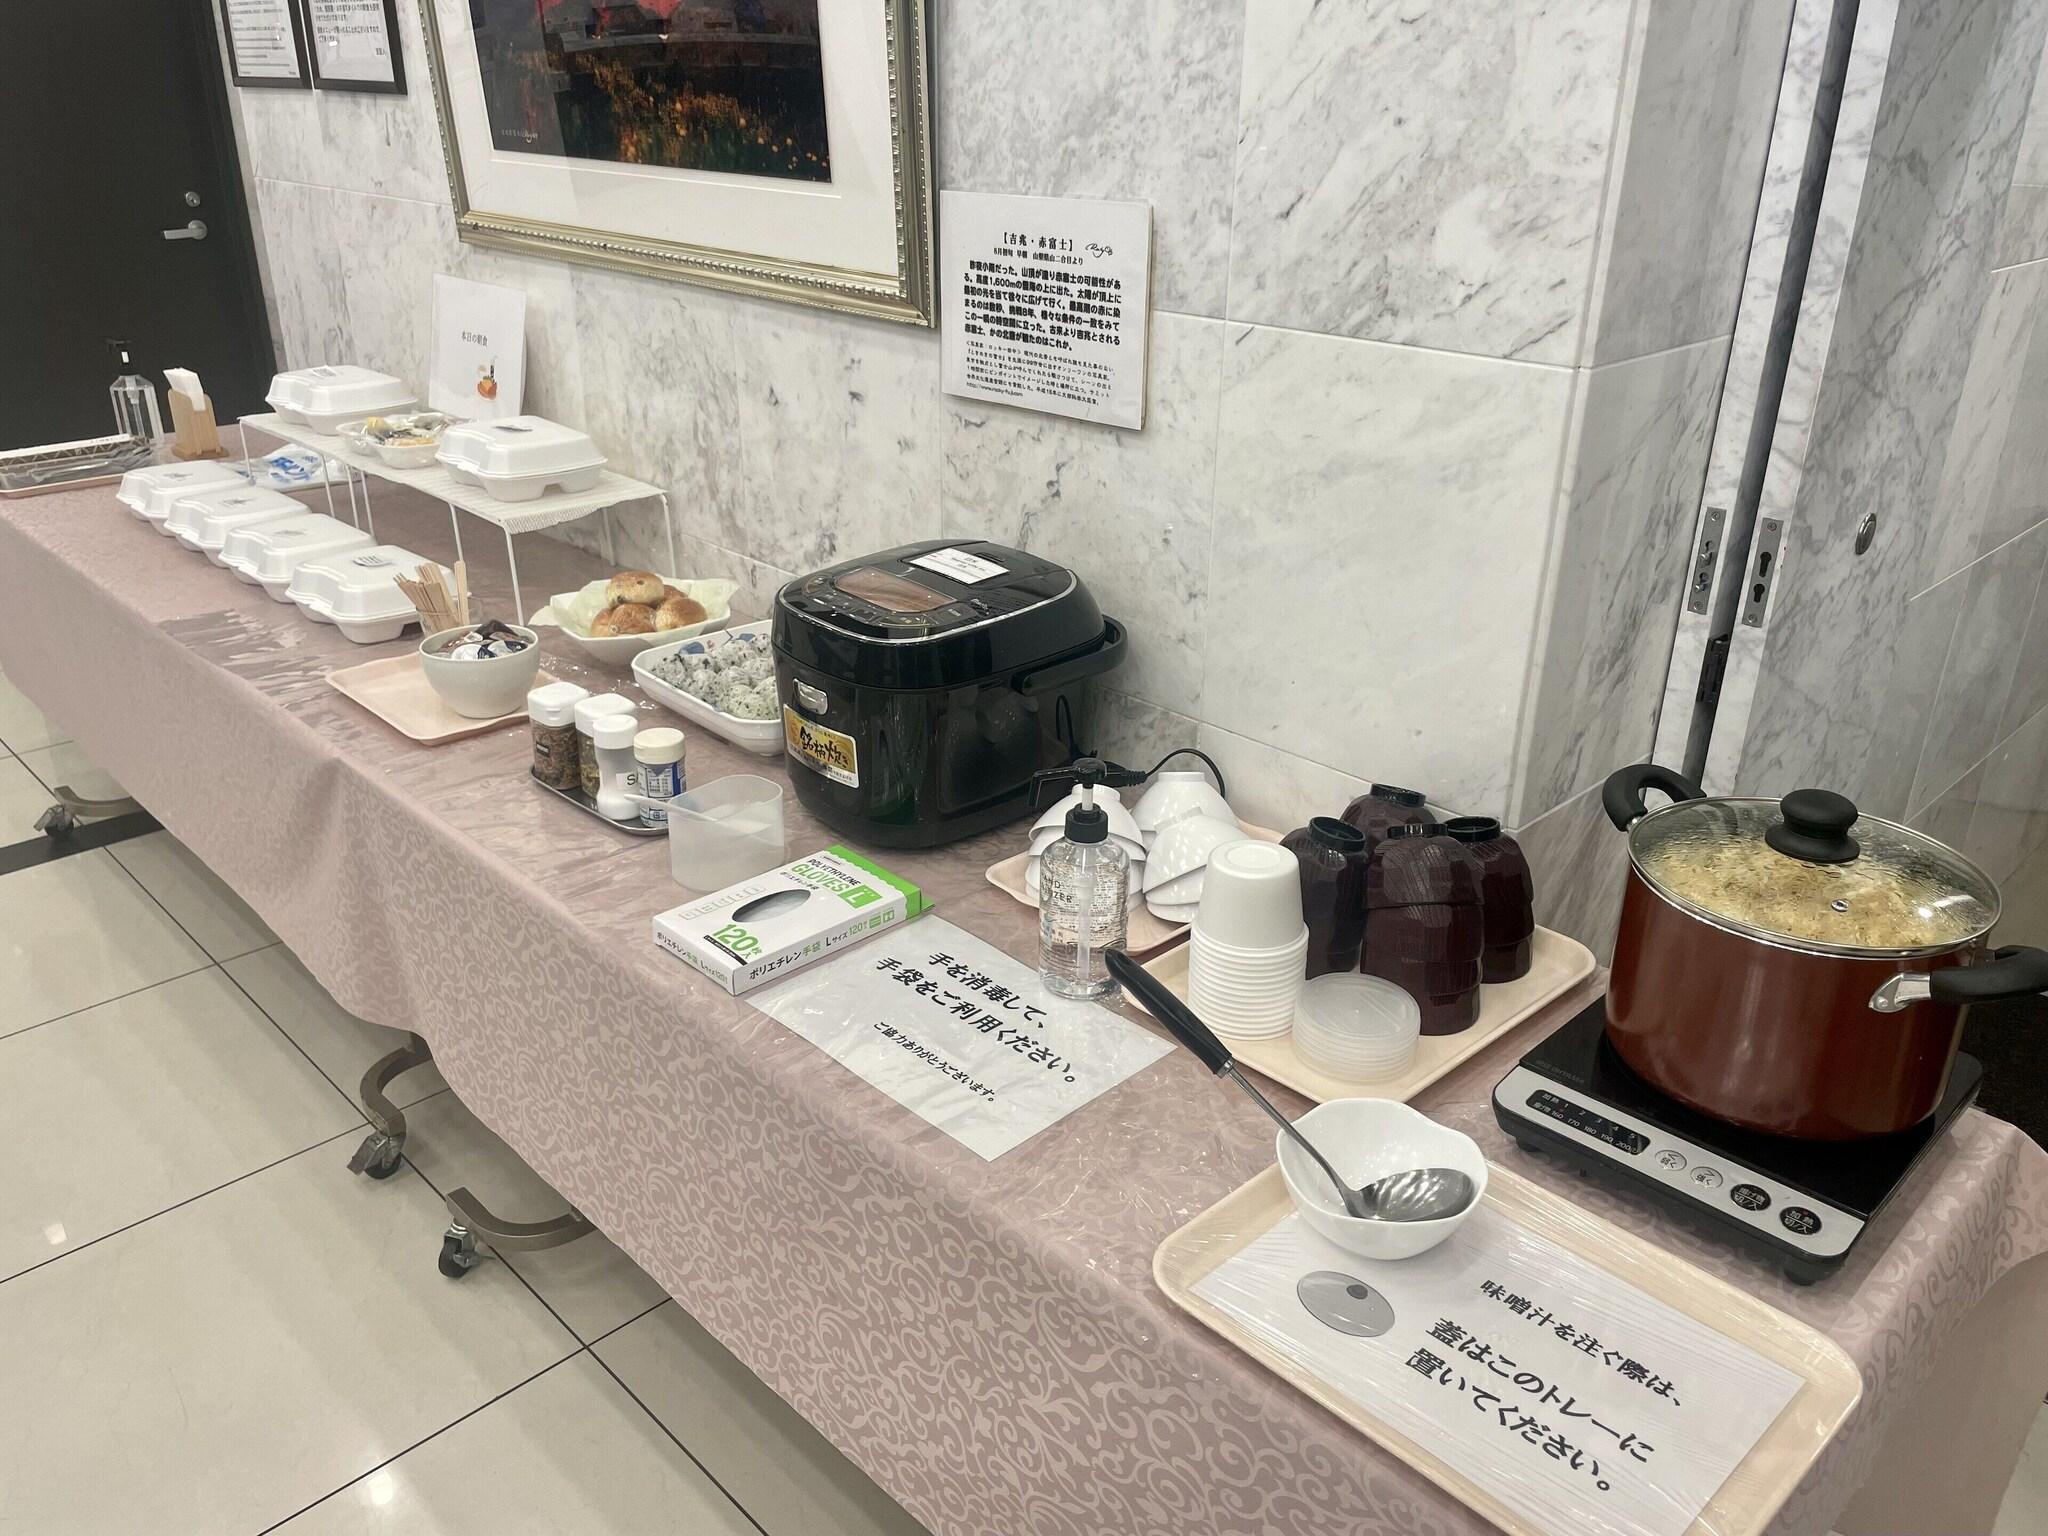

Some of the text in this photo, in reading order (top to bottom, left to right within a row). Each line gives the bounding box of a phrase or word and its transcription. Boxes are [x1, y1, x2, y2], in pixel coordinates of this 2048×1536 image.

[1003, 232, 1073, 251] 【吉兆・赤富士】
[791, 863, 851, 892] GLOVES
[808, 858, 861, 885] POLYETHYLENE
[712, 924, 759, 951] 120
[749, 940, 821, 980] ポリエチレン手袋
[927, 951, 1048, 1030] 手を消毒して、
[875, 957, 1076, 1084] 手袋をご利用ください。
[872, 1020, 995, 1103] ご協力ありがとうございます。
[1567, 1118, 1580, 1127] 170
[1583, 1126, 1597, 1135] 180
[1480, 1279, 1682, 1407] 味噌汁を注ぐ際は、
[1404, 1347, 1611, 1492] 置いてください。
[1425, 1317, 1655, 1463] 蓋はこのトレーに
